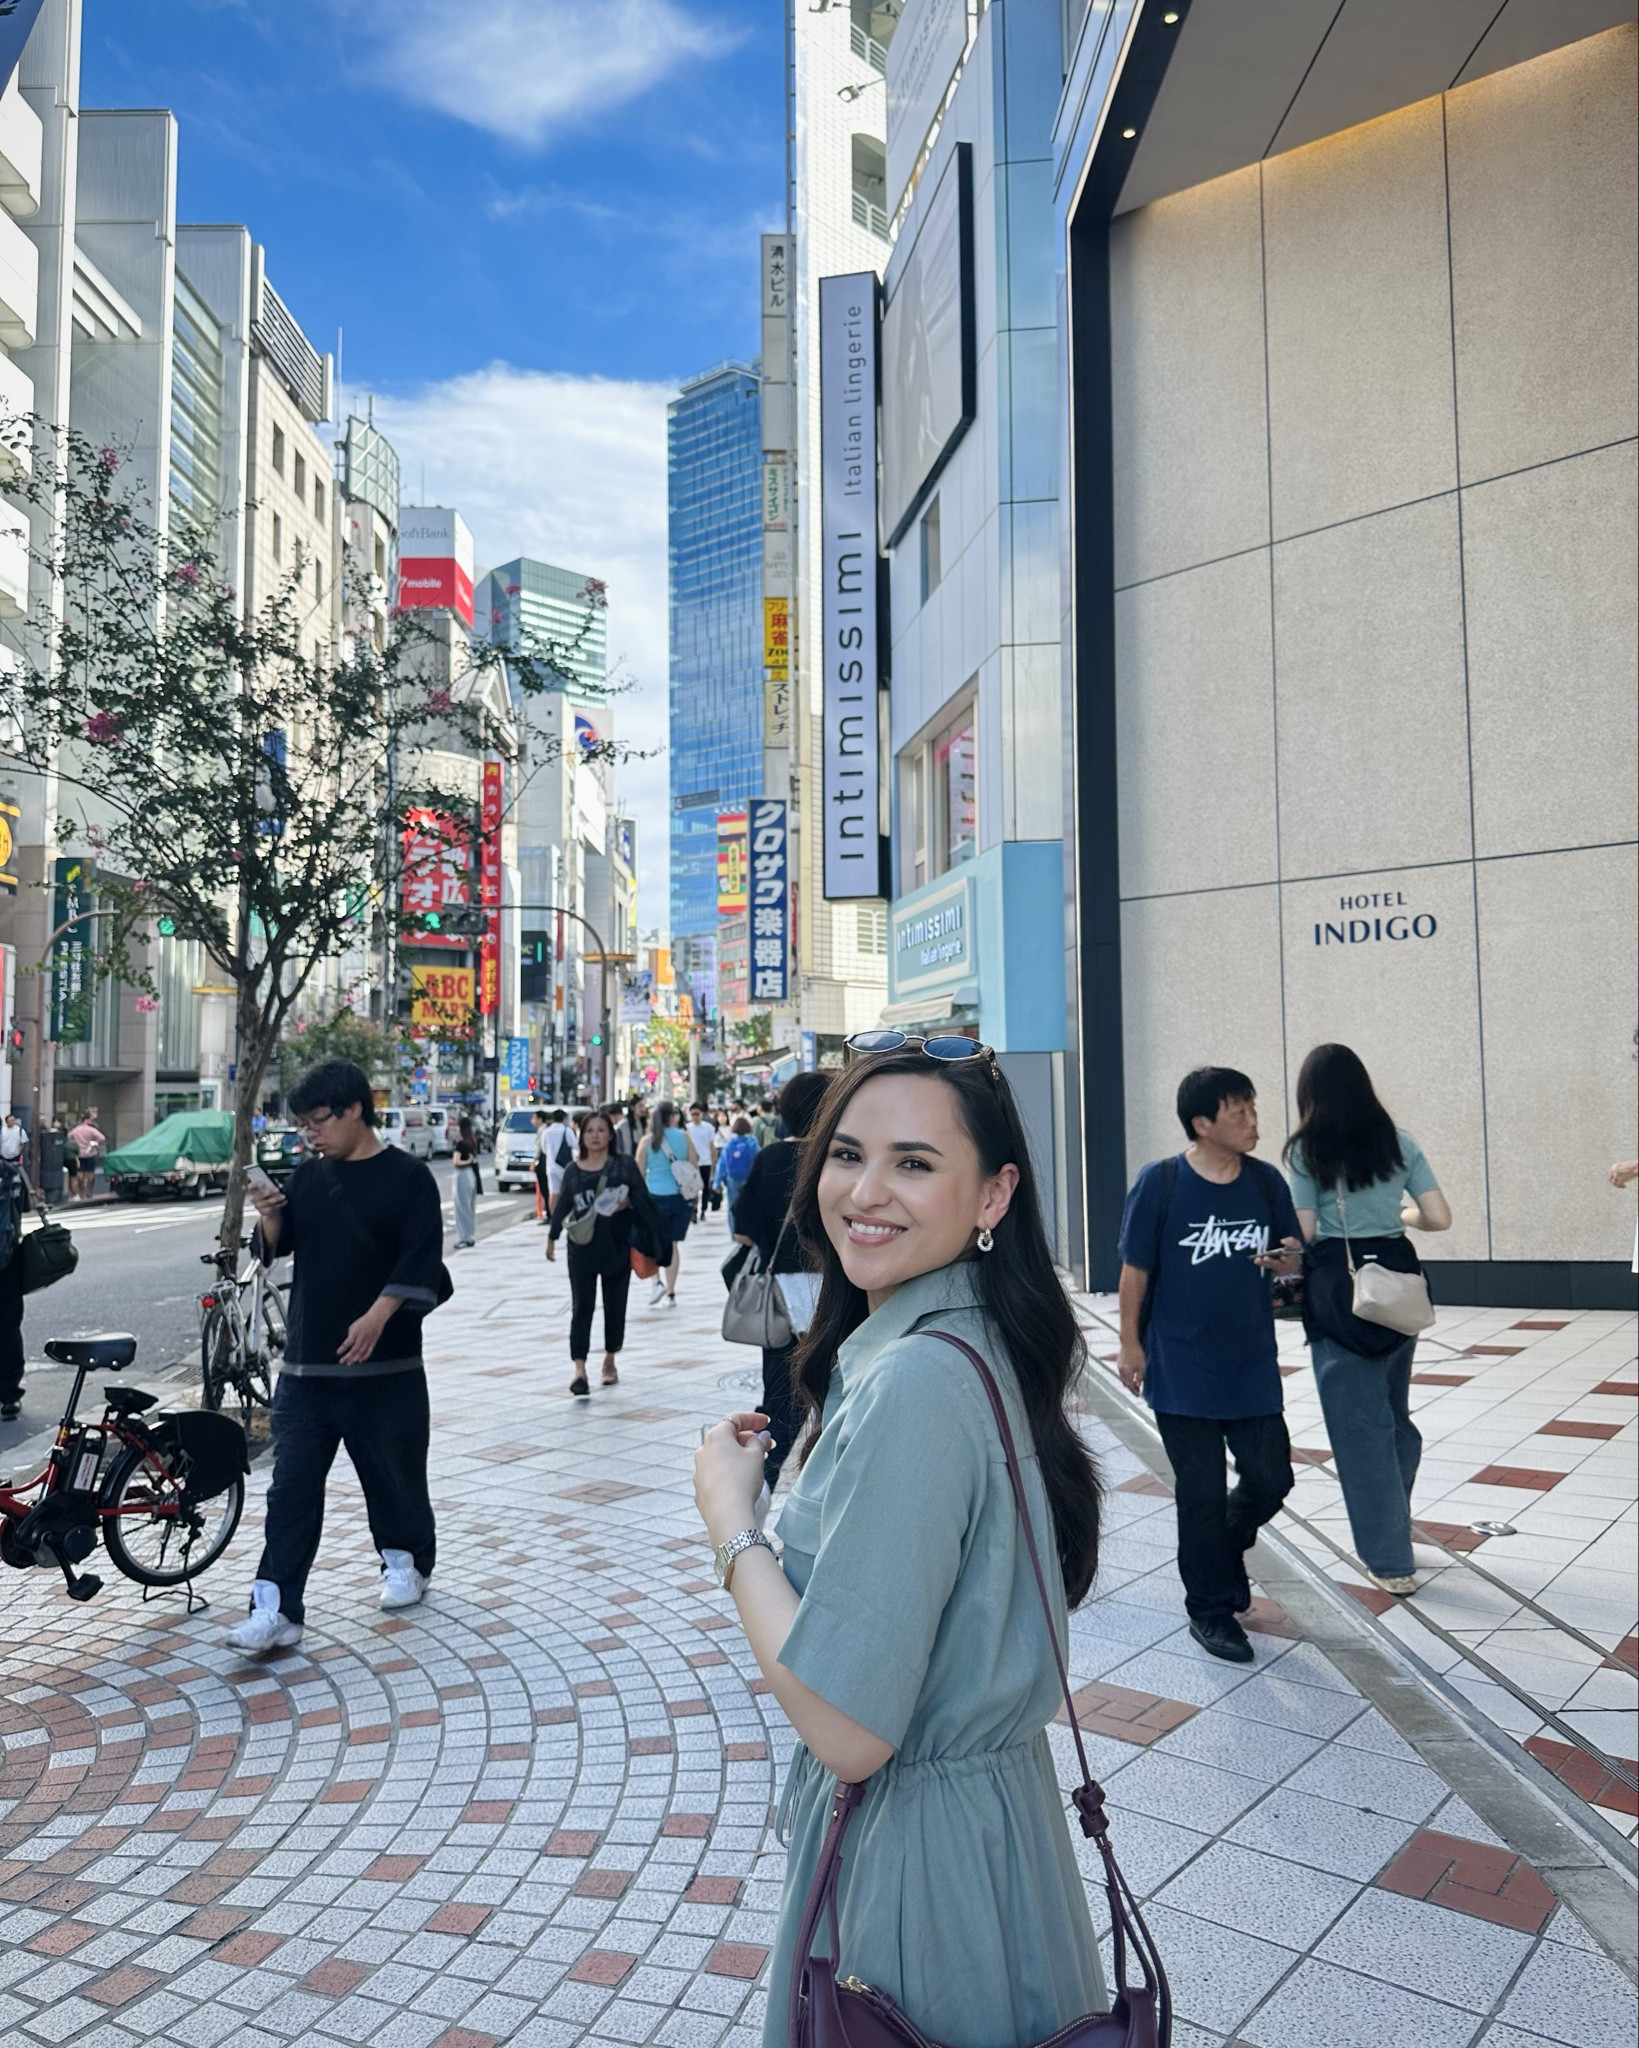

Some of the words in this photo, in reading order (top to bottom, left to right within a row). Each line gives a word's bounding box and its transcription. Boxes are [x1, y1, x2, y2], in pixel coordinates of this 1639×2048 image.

[843, 305, 866, 404] lingerie
[844, 414, 862, 497] Italian
[833, 532, 864, 860] intimissimi
[754, 802, 785, 998] クロサワ楽器店
[1315, 913, 1437, 946] INDIGO
[1340, 892, 1407, 910] HOTEL
[424, 974, 468, 1000] ABC
